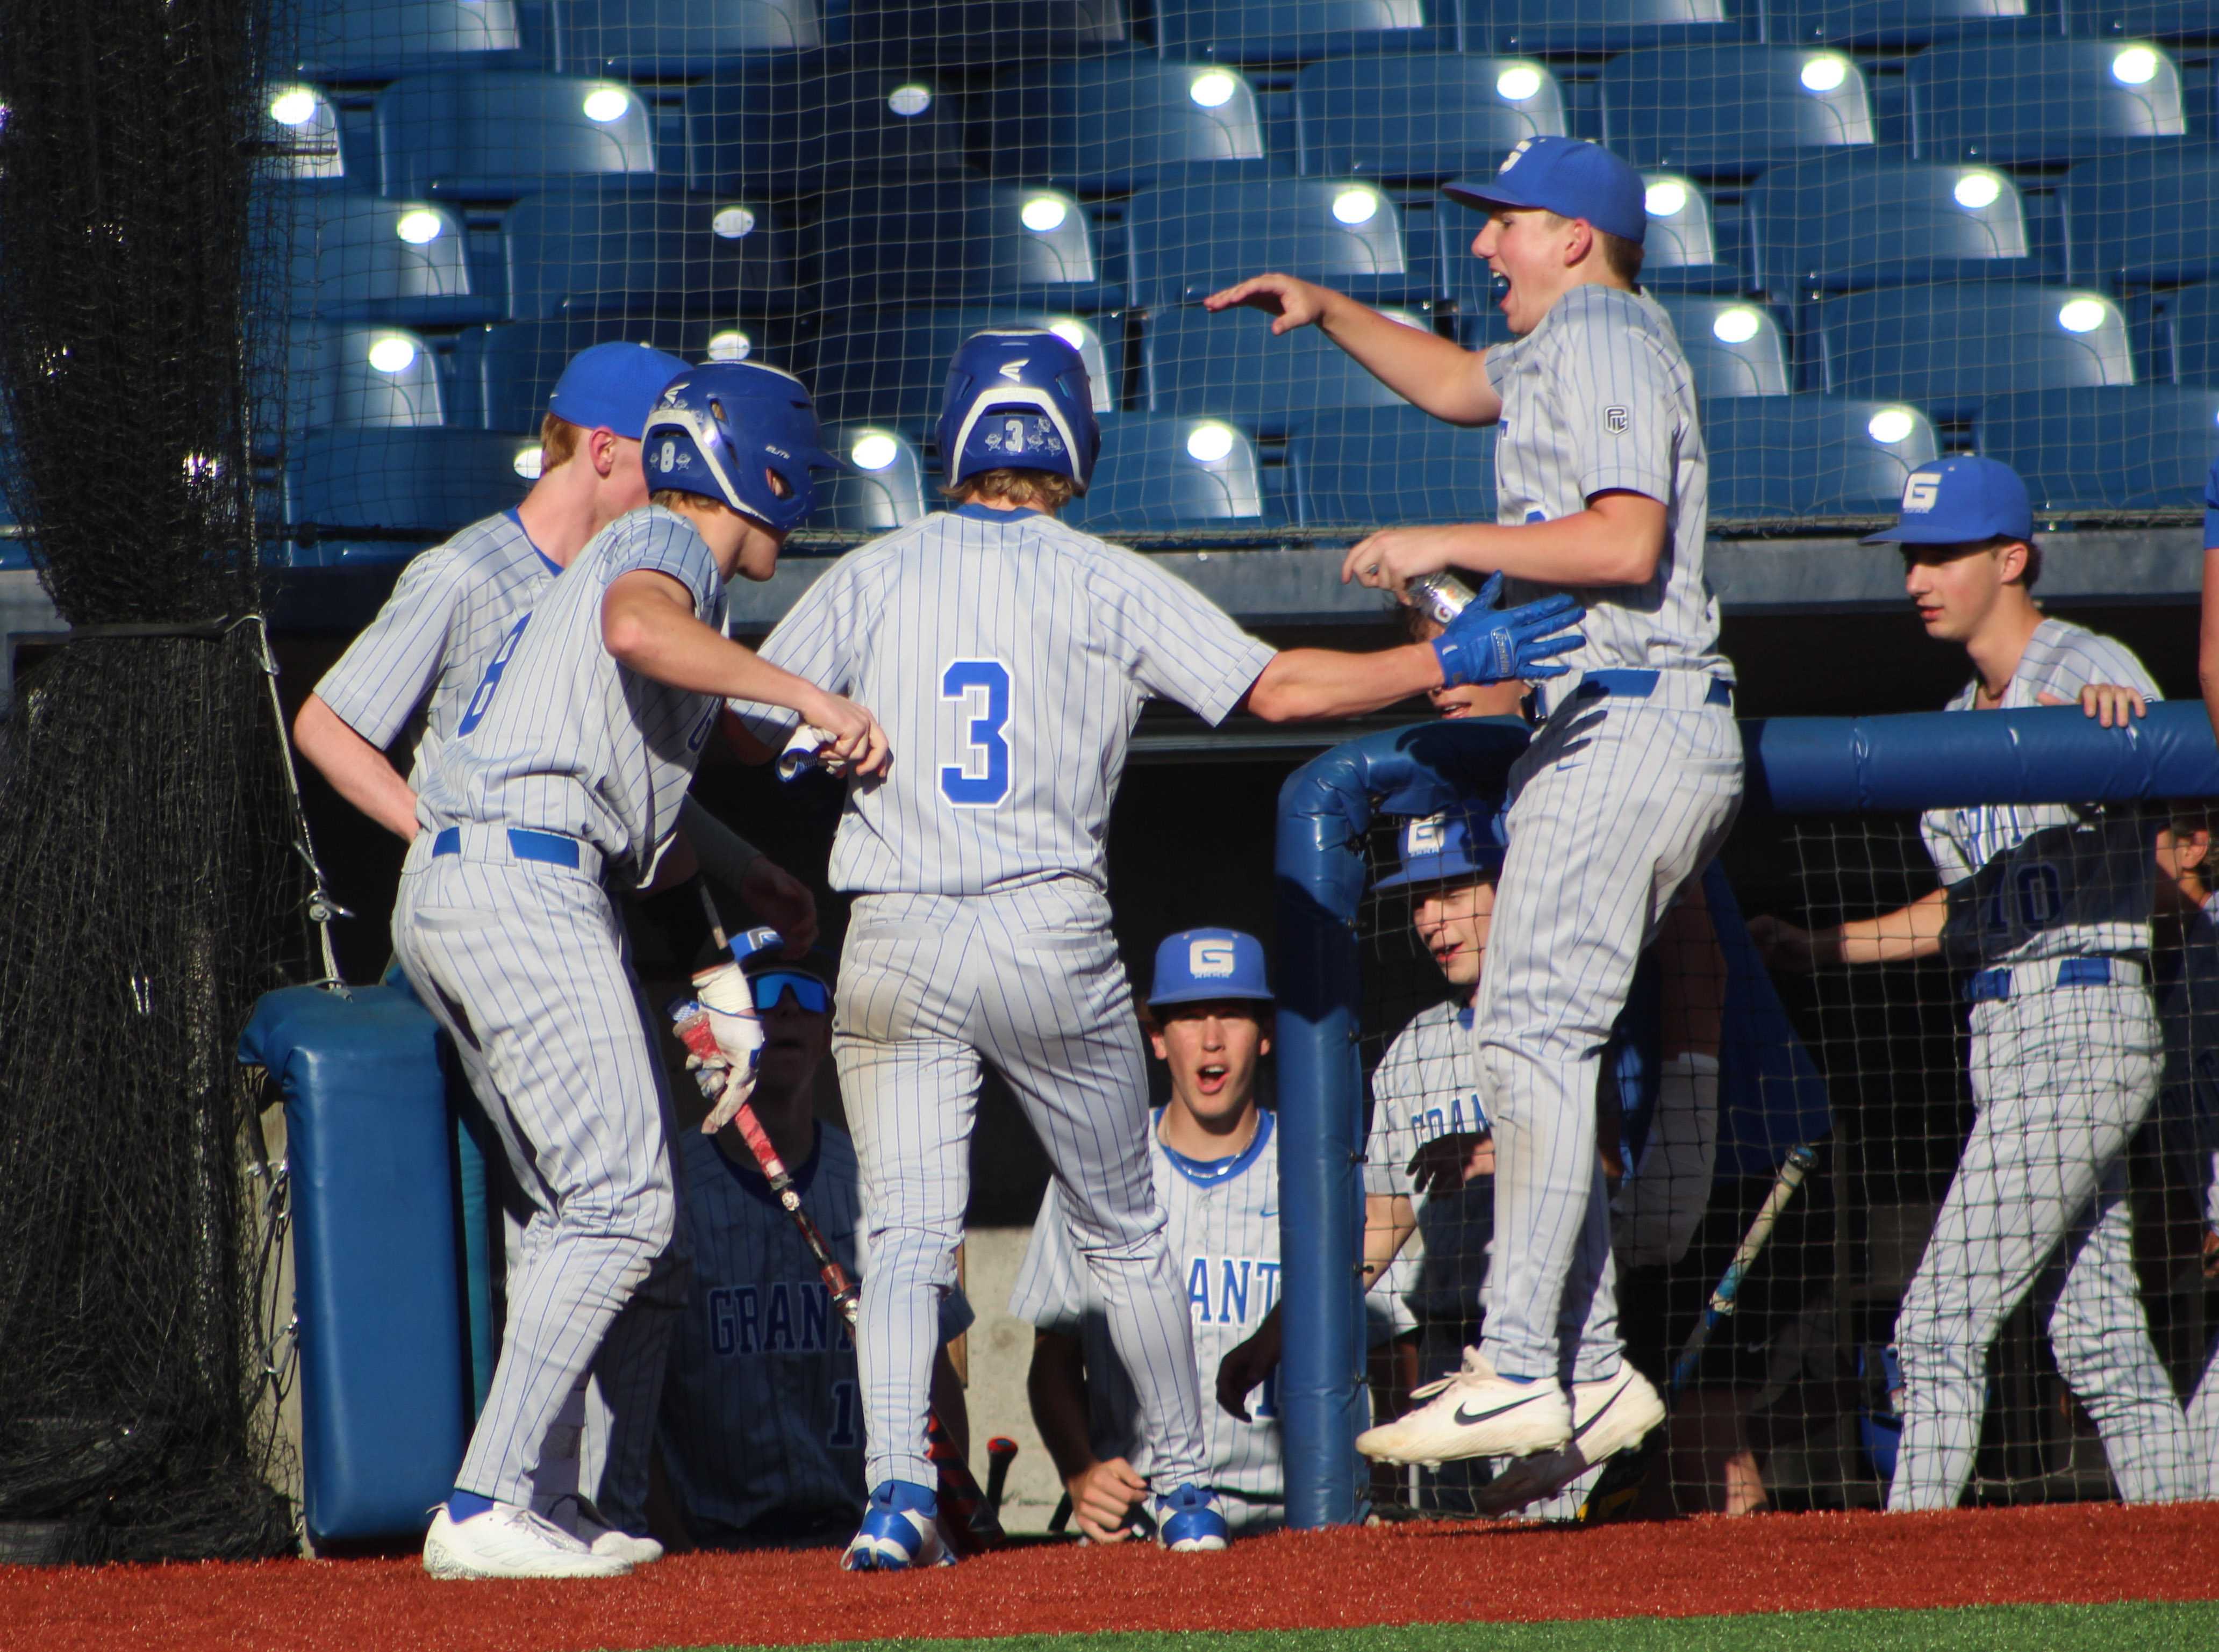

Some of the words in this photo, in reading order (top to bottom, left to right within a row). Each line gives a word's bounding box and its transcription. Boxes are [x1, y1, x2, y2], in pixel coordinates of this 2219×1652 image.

[1005, 420, 1023, 452] 3
[660, 441, 675, 473] 8
[1902, 472, 1942, 509] G
[456, 609, 534, 740] 8
[939, 658, 1014, 809] 3
[1408, 812, 1445, 853] G
[1190, 939, 1234, 974] G
